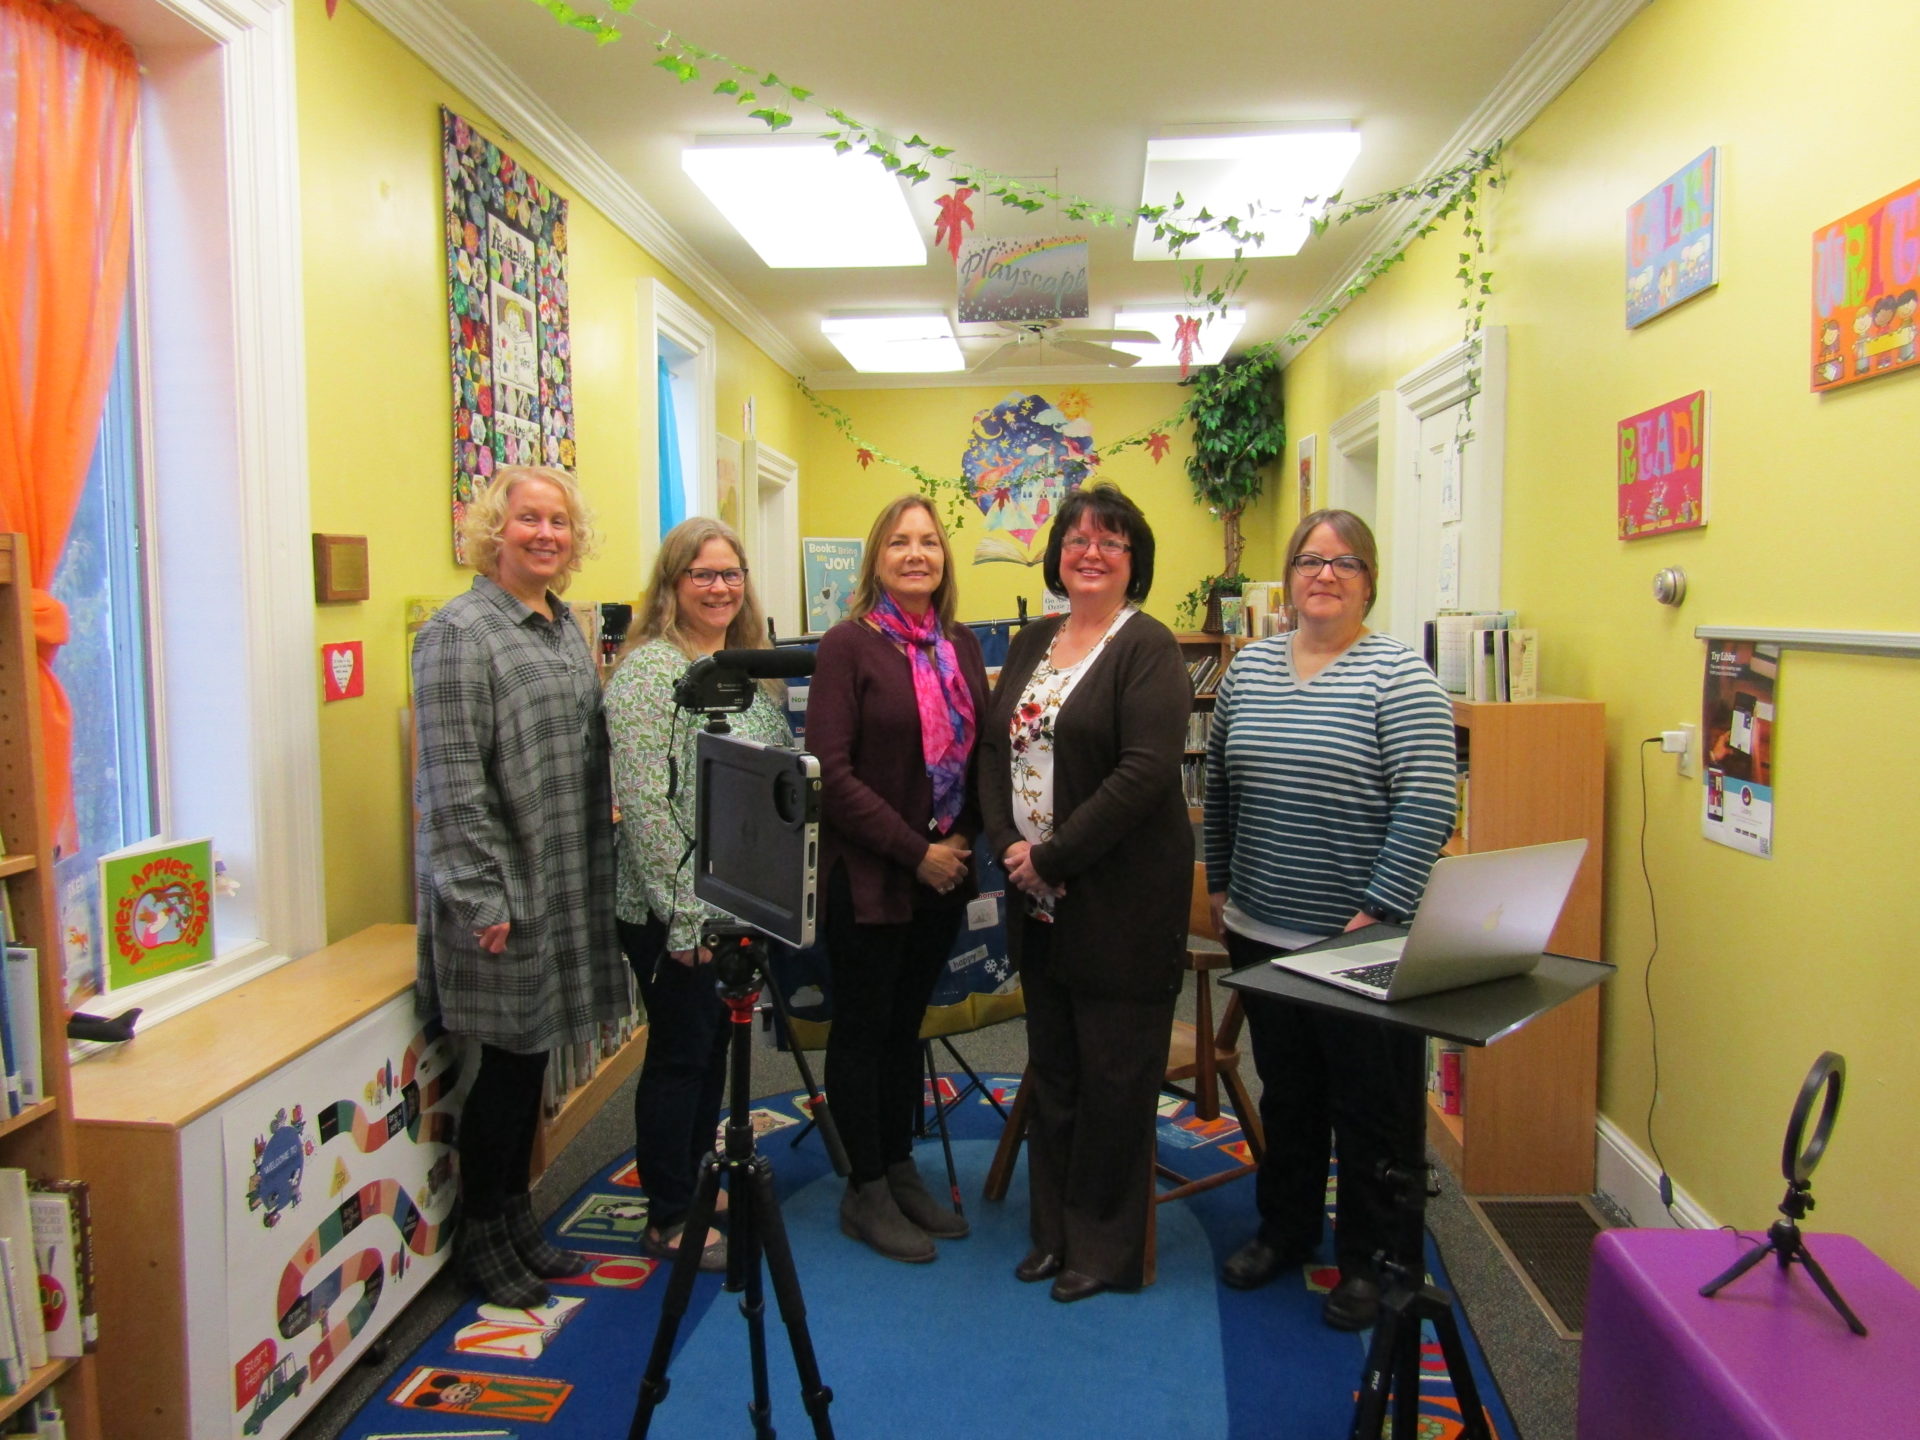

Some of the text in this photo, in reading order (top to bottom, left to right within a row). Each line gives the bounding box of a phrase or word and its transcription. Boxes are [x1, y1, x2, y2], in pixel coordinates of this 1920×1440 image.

[1628, 151, 1713, 268] TALK!
[1815, 189, 1920, 318] WRIT
[960, 245, 1087, 311] Playscape
[1619, 393, 1702, 486] READ!
[808, 543, 837, 554] Books
[825, 558, 855, 570] JOY!
[1711, 651, 1720, 663] Try
[953, 953, 977, 969] happy
[263, 1148, 290, 1175] WELCOME
[244, 1345, 269, 1376] Start
